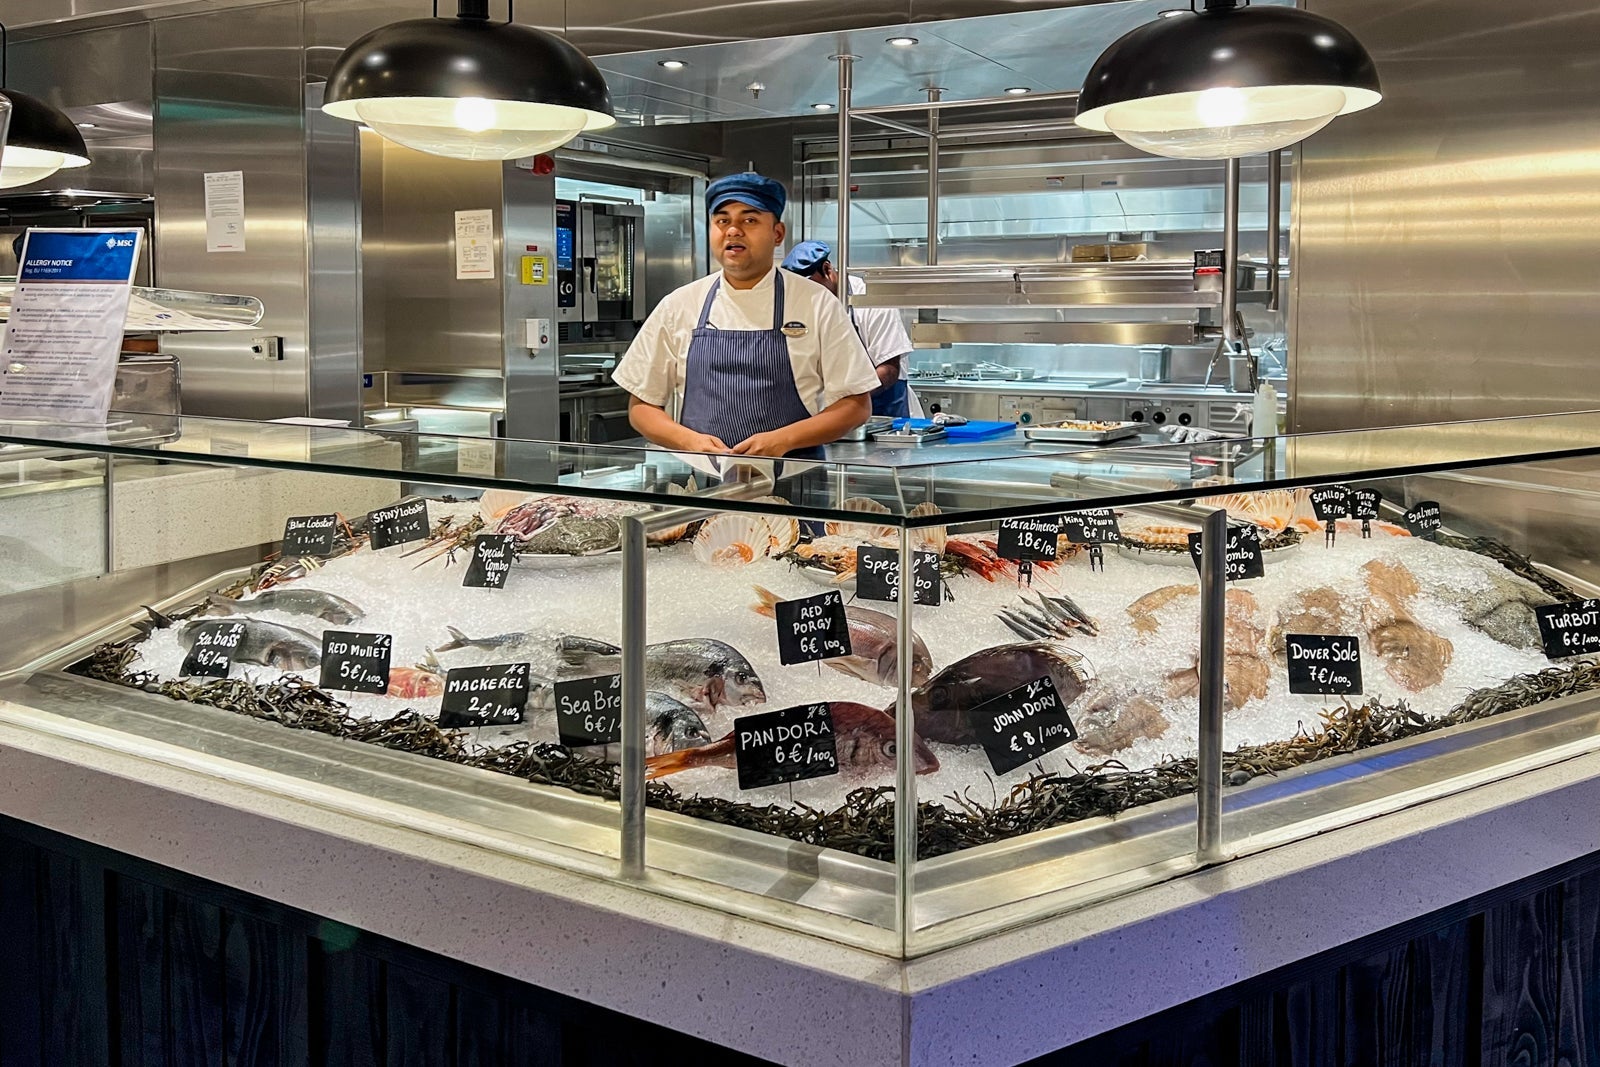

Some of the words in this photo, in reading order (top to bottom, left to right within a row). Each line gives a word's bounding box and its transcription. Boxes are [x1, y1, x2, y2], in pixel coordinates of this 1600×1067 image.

[116, 239, 134, 247] MSC
[26, 259, 51, 267] ALLERGY
[51, 259, 73, 267] NOTICE
[1312, 490, 1345, 503] SCALLOP
[1063, 515, 1085, 527] King
[1087, 517, 1114, 526] Prawn
[1408, 506, 1440, 523] Salmon
[289, 520, 306, 530] Blue
[306, 517, 334, 529] Lobster
[1001, 518, 1059, 534] Carabineros
[478, 541, 505, 562] Special
[1225, 547, 1255, 562] ombo
[485, 558, 509, 572] Combo
[863, 554, 921, 574] Specil
[885, 571, 932, 590] Cobo
[801, 605, 823, 620] RED
[793, 617, 832, 635] PORGY
[195, 631, 213, 646] Sea
[212, 629, 241, 648] bass
[327, 641, 348, 655] RED
[1331, 641, 1359, 662] Sole
[448, 677, 524, 693] MACKEREL
[560, 695, 591, 715] Sea
[593, 690, 621, 710] Bre
[1022, 694, 1056, 717] DORY
[740, 720, 831, 751] PANDORA
